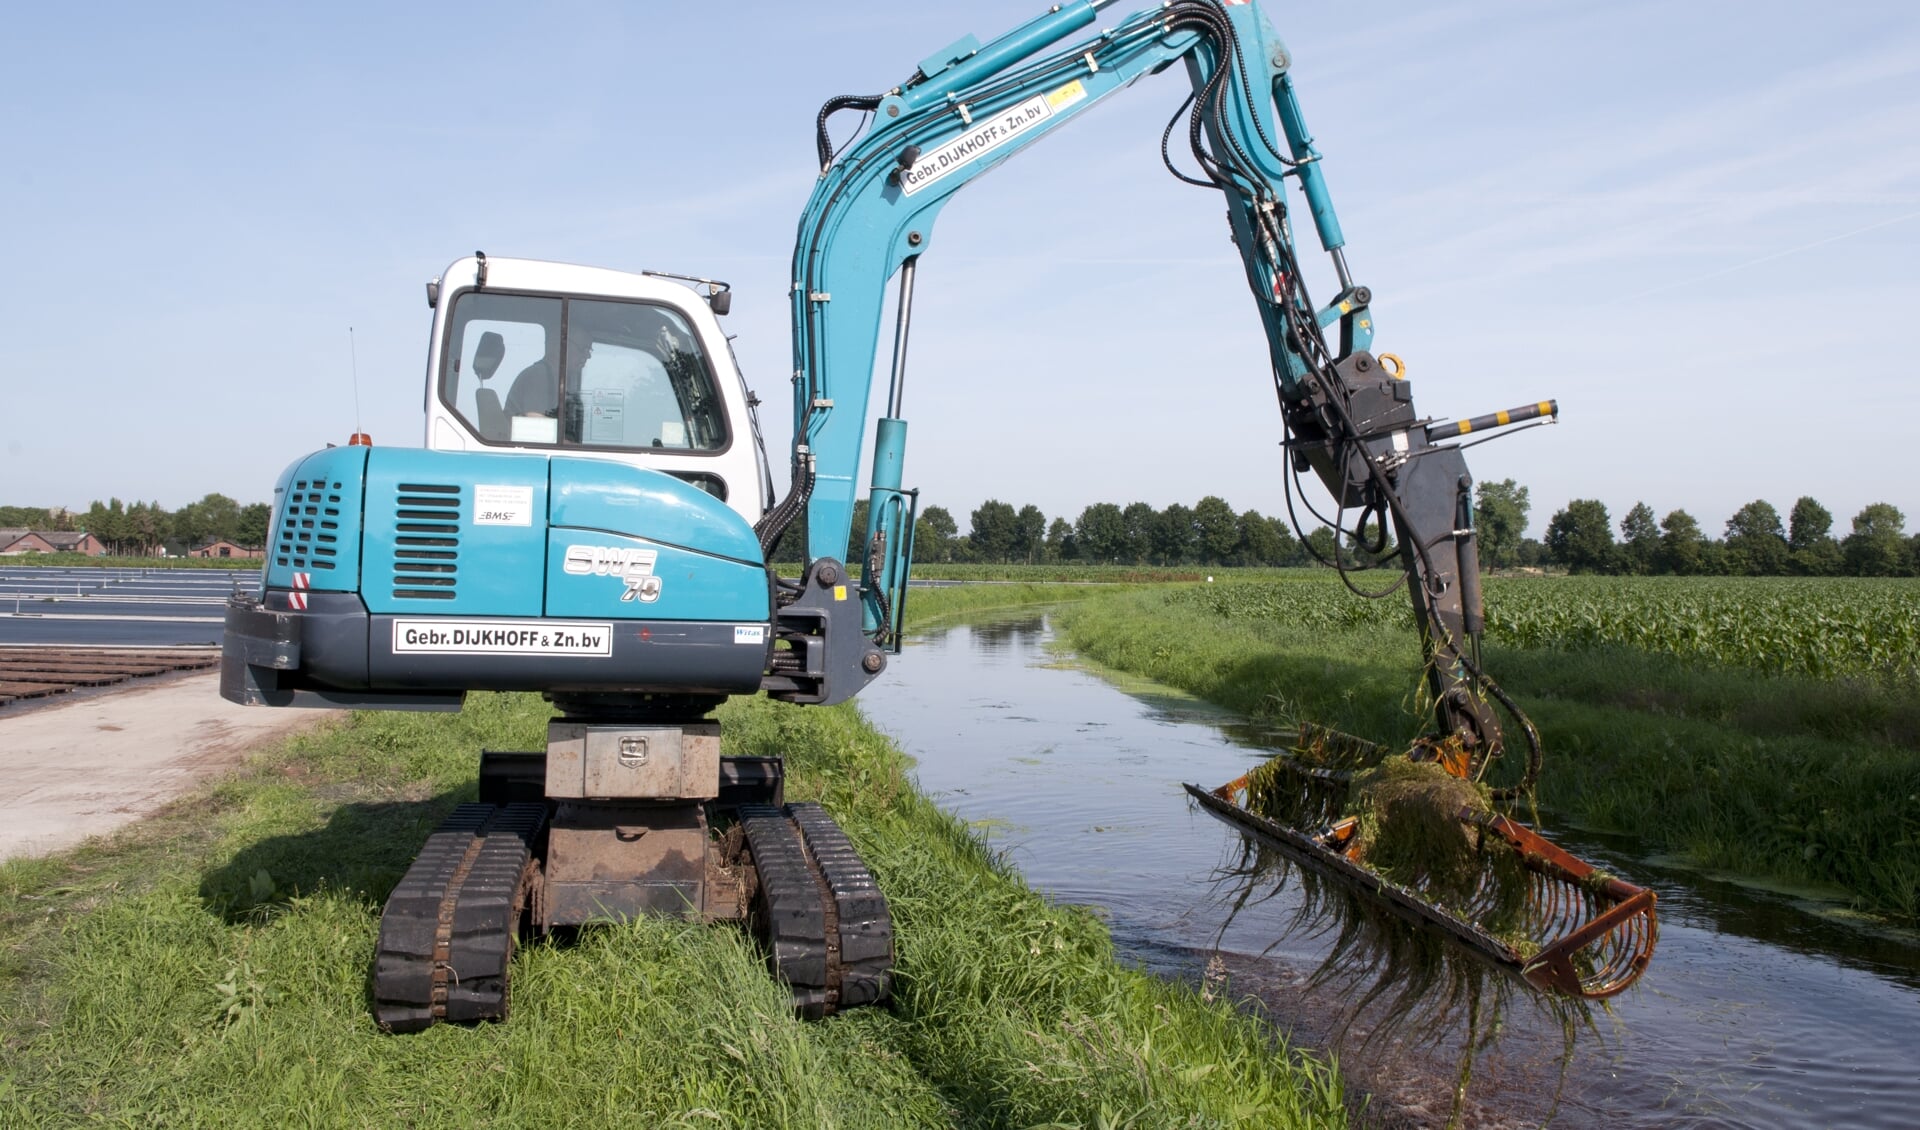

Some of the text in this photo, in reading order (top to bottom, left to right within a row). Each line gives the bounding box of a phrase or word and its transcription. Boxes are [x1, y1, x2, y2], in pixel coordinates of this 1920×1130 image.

[999, 125, 1008, 136] &
[565, 546, 656, 576] SWE
[621, 576, 661, 602] 70
[541, 635, 550, 647] &
